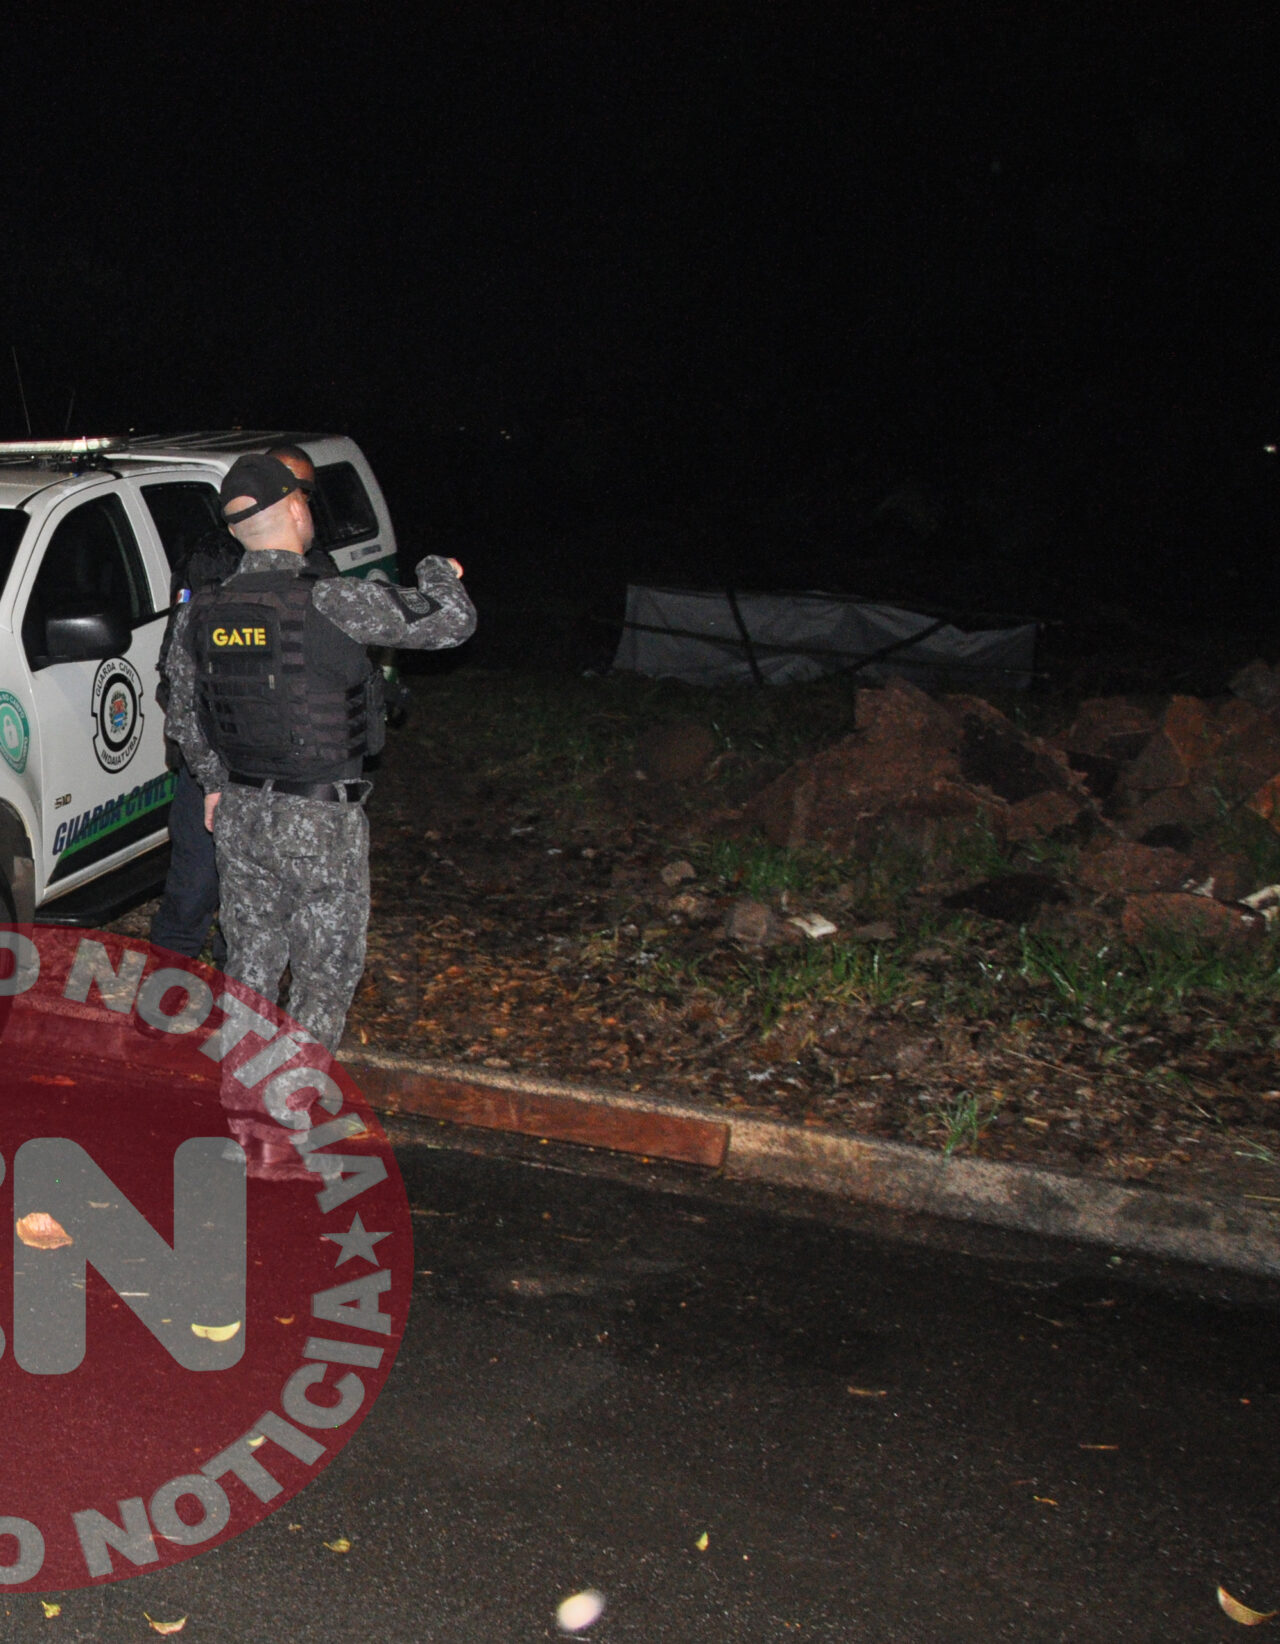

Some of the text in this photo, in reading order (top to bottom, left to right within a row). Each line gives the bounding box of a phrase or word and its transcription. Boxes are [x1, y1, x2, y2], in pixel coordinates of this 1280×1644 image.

[212, 628, 267, 647] GATE
[96, 662, 135, 697] GUARDA CIVIL
[101, 735, 138, 766] INDAIATUBA
[52, 793, 126, 856] GUARDA
[125, 771, 168, 816] CIVIL
